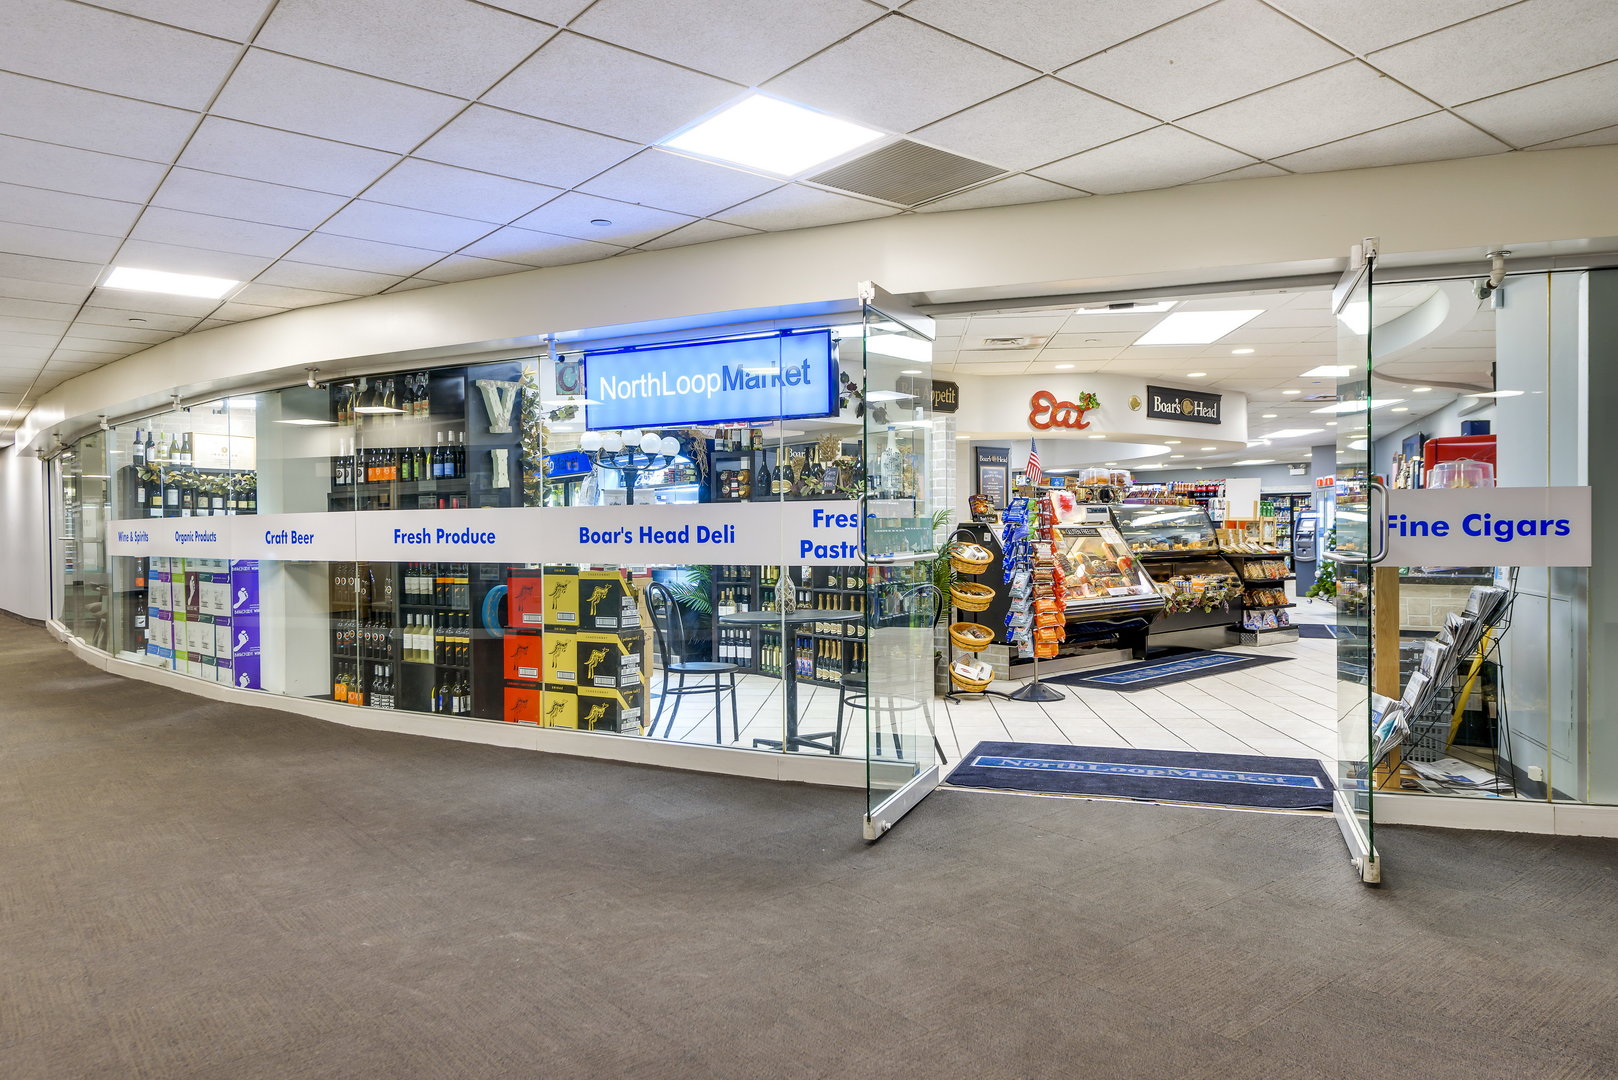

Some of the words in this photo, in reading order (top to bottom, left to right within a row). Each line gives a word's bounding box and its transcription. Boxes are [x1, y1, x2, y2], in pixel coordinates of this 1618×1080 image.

[600, 357, 811, 400] NorthLoopMarket
[1029, 390, 1092, 430] Eat
[1153, 396, 1180, 414] Boar's
[1193, 401, 1217, 418] Head
[118, 531, 129, 542] Wine
[134, 531, 149, 544] Spirits
[175, 531, 194, 544] Organic
[194, 531, 217, 542] Products
[265, 530, 288, 544] Craft
[291, 531, 314, 544] Beer
[394, 528, 431, 544] Fresh
[436, 527, 496, 544] Produce
[579, 526, 633, 544] Boar's
[639, 525, 689, 544] Head
[697, 524, 735, 544] Deli
[1462, 513, 1570, 542] Cigars
[800, 539, 868, 558] Pastr
[1000, 758, 1287, 784] NorthLoopMarket
